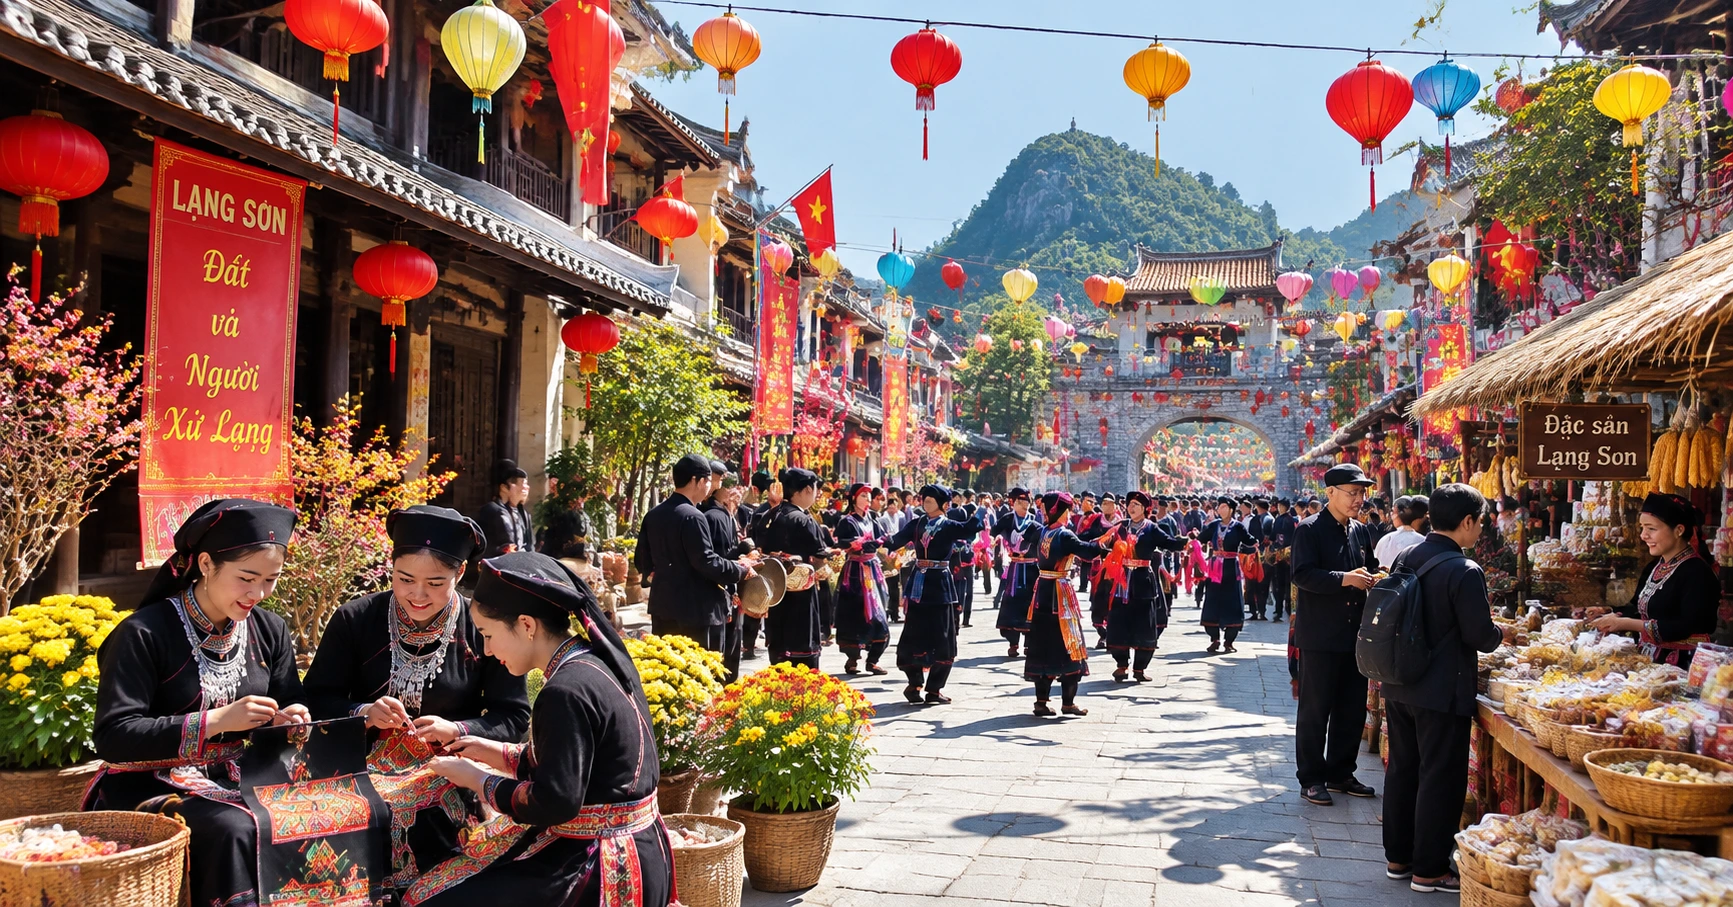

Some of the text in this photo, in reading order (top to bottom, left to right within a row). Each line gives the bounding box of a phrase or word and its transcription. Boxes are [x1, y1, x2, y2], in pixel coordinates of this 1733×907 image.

[172, 179, 235, 224] LẠNG
[203, 249, 251, 289] Đất
[184, 352, 260, 398] Người
[1536, 444, 1590, 471] Lạng
